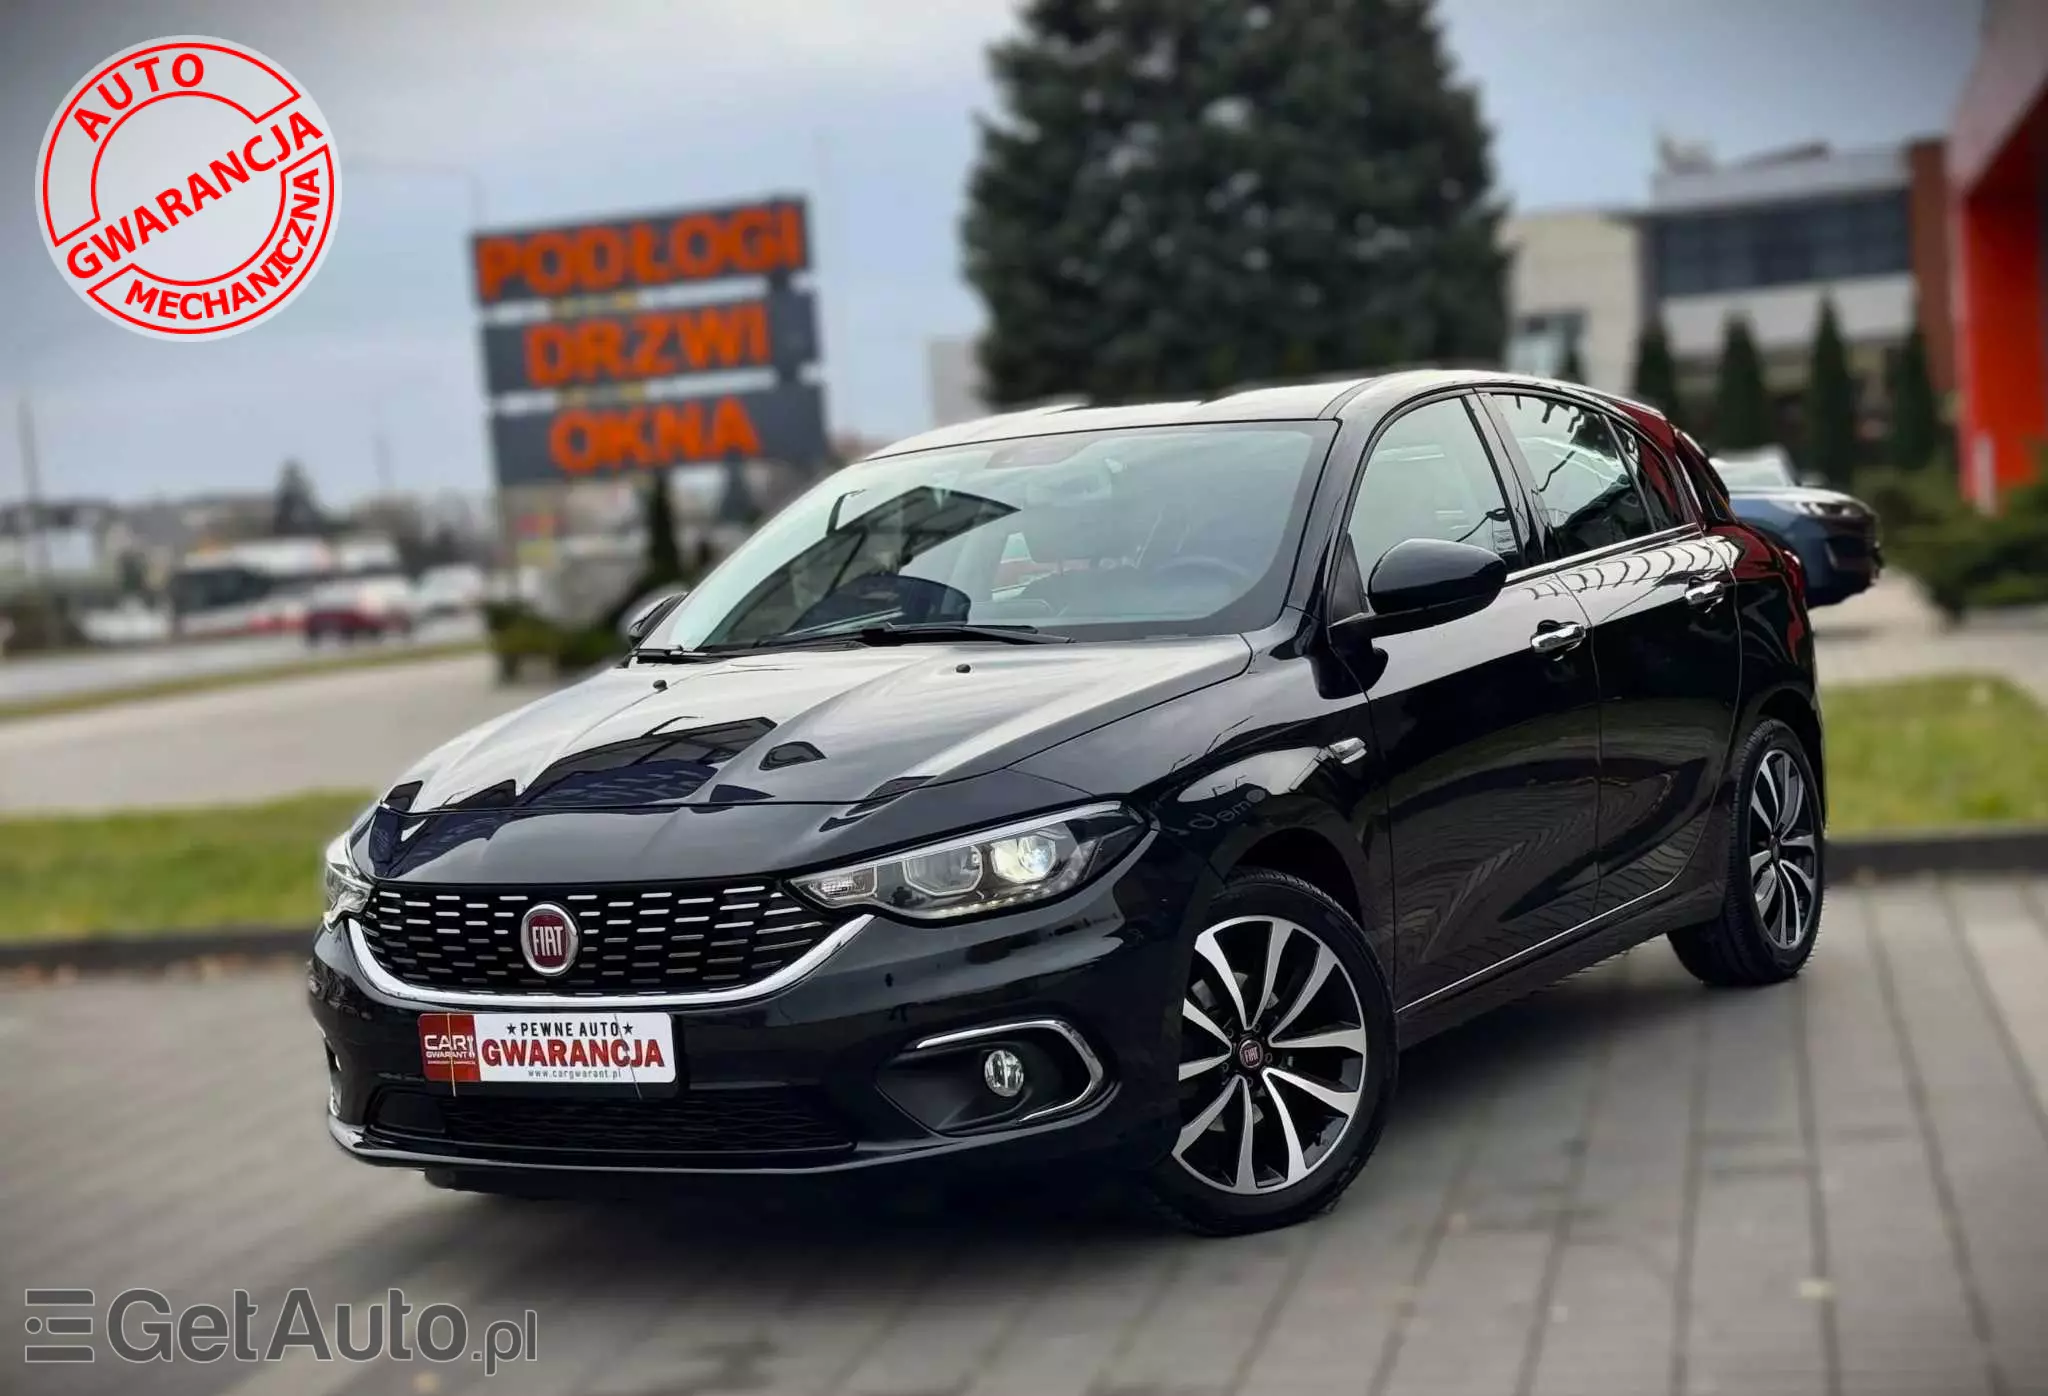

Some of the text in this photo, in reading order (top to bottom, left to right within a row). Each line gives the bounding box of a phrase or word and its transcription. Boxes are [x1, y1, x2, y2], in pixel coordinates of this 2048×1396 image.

[524, 302, 769, 386] DRZWI
[549, 396, 760, 471] OKNA
[531, 925, 564, 956] FIAT
[424, 1035, 467, 1050] CAR
[520, 1021, 619, 1037] PEWNE AUTO
[481, 1039, 665, 1067] GWARANCJA
[527, 1067, 622, 1079] www.cargwarant.pl
